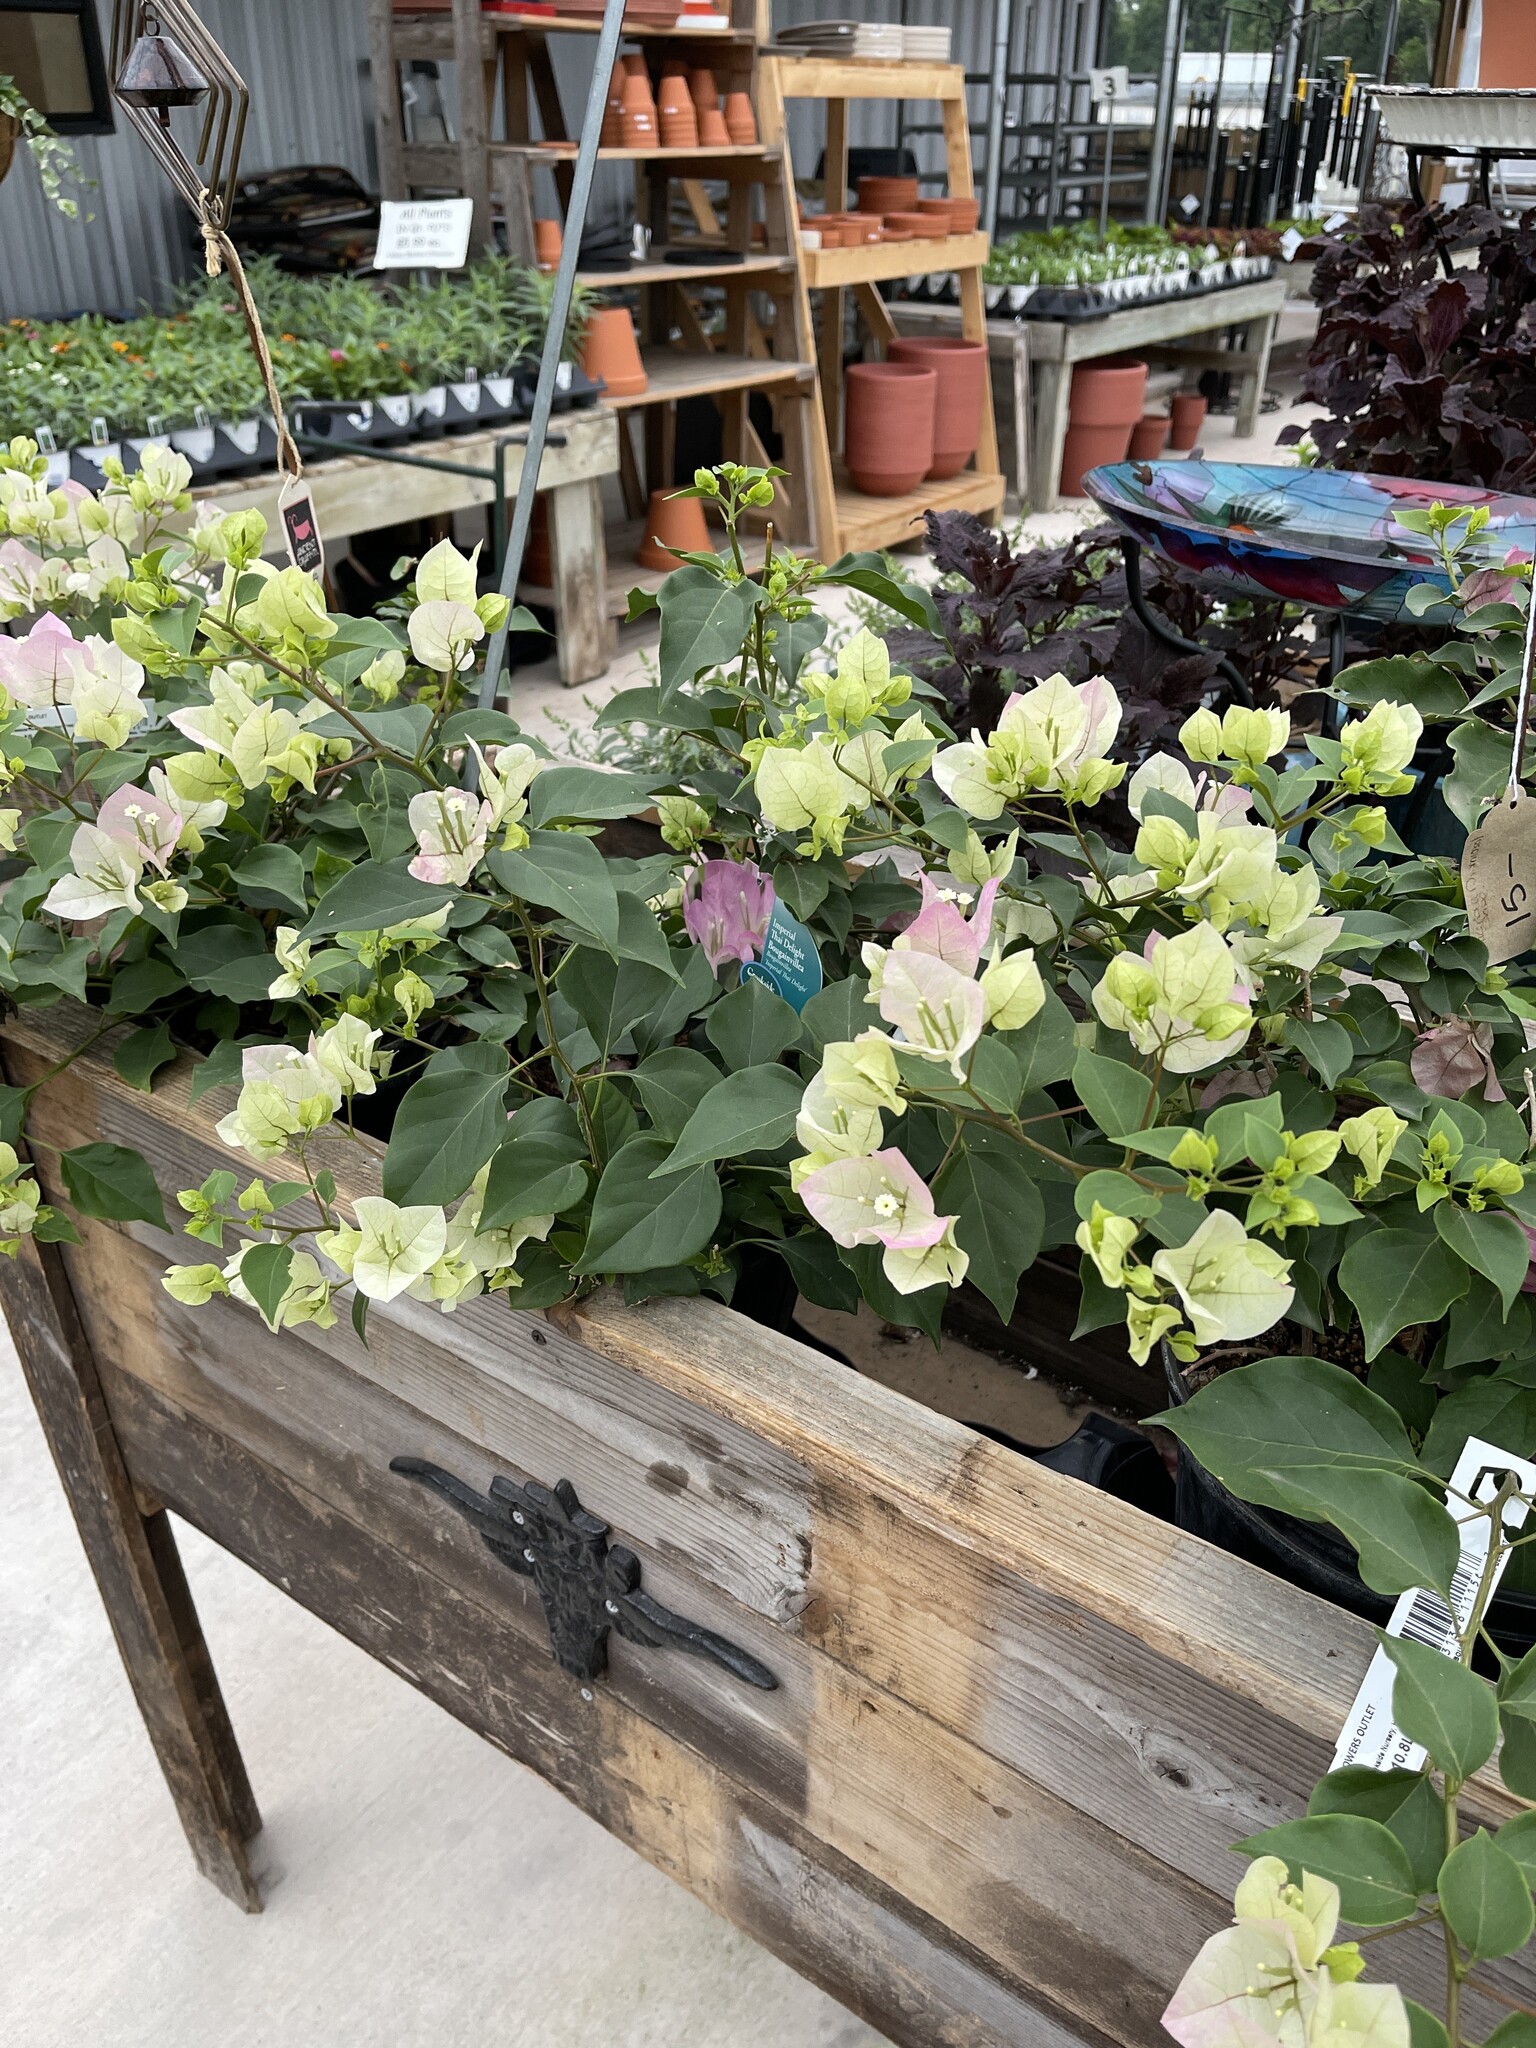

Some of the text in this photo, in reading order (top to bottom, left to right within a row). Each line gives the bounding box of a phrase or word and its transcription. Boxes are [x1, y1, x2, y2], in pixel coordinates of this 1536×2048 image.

[1103, 76, 1116, 96] 3
[772, 918, 797, 941] Imperial
[768, 940, 805, 973] Bougainvillea
[771, 929, 805, 960] Thai Delight
[782, 971, 791, 982] Thai
[1356, 1703, 1376, 1737] OUTLET
